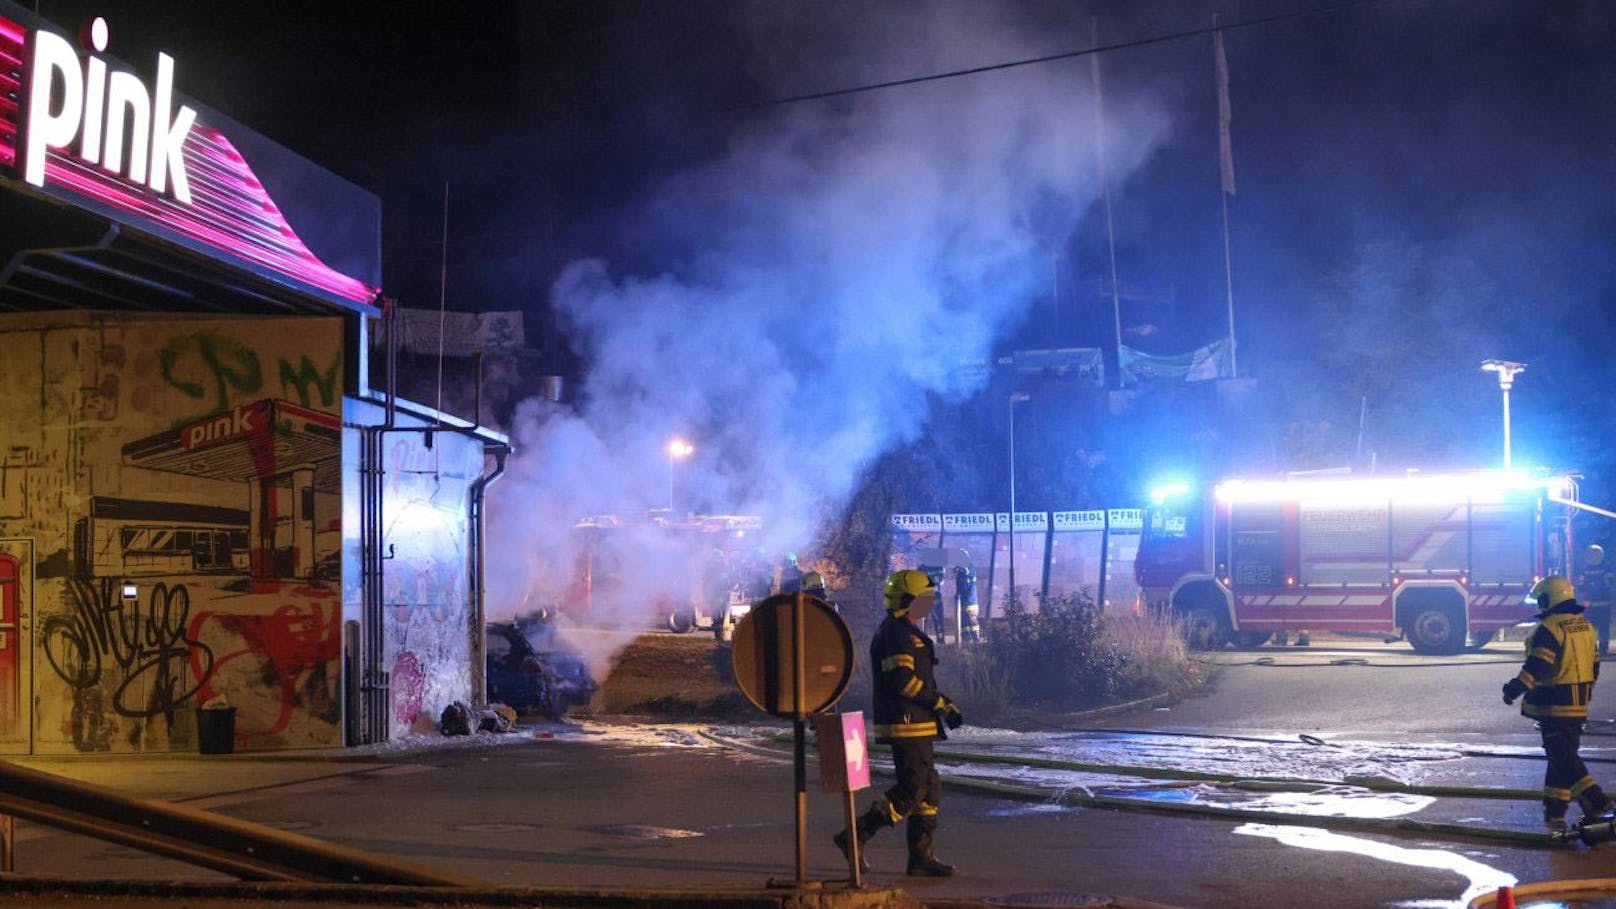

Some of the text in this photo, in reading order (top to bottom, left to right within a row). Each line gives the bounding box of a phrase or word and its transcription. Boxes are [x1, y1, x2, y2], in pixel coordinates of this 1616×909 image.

[25, 16, 198, 206] pink
[189, 406, 255, 449] pink
[902, 514, 940, 525] FRIEDL
[954, 513, 993, 525] FRIEDL
[1014, 513, 1046, 523] RIEDL
[1065, 511, 1102, 522] FRIEDL
